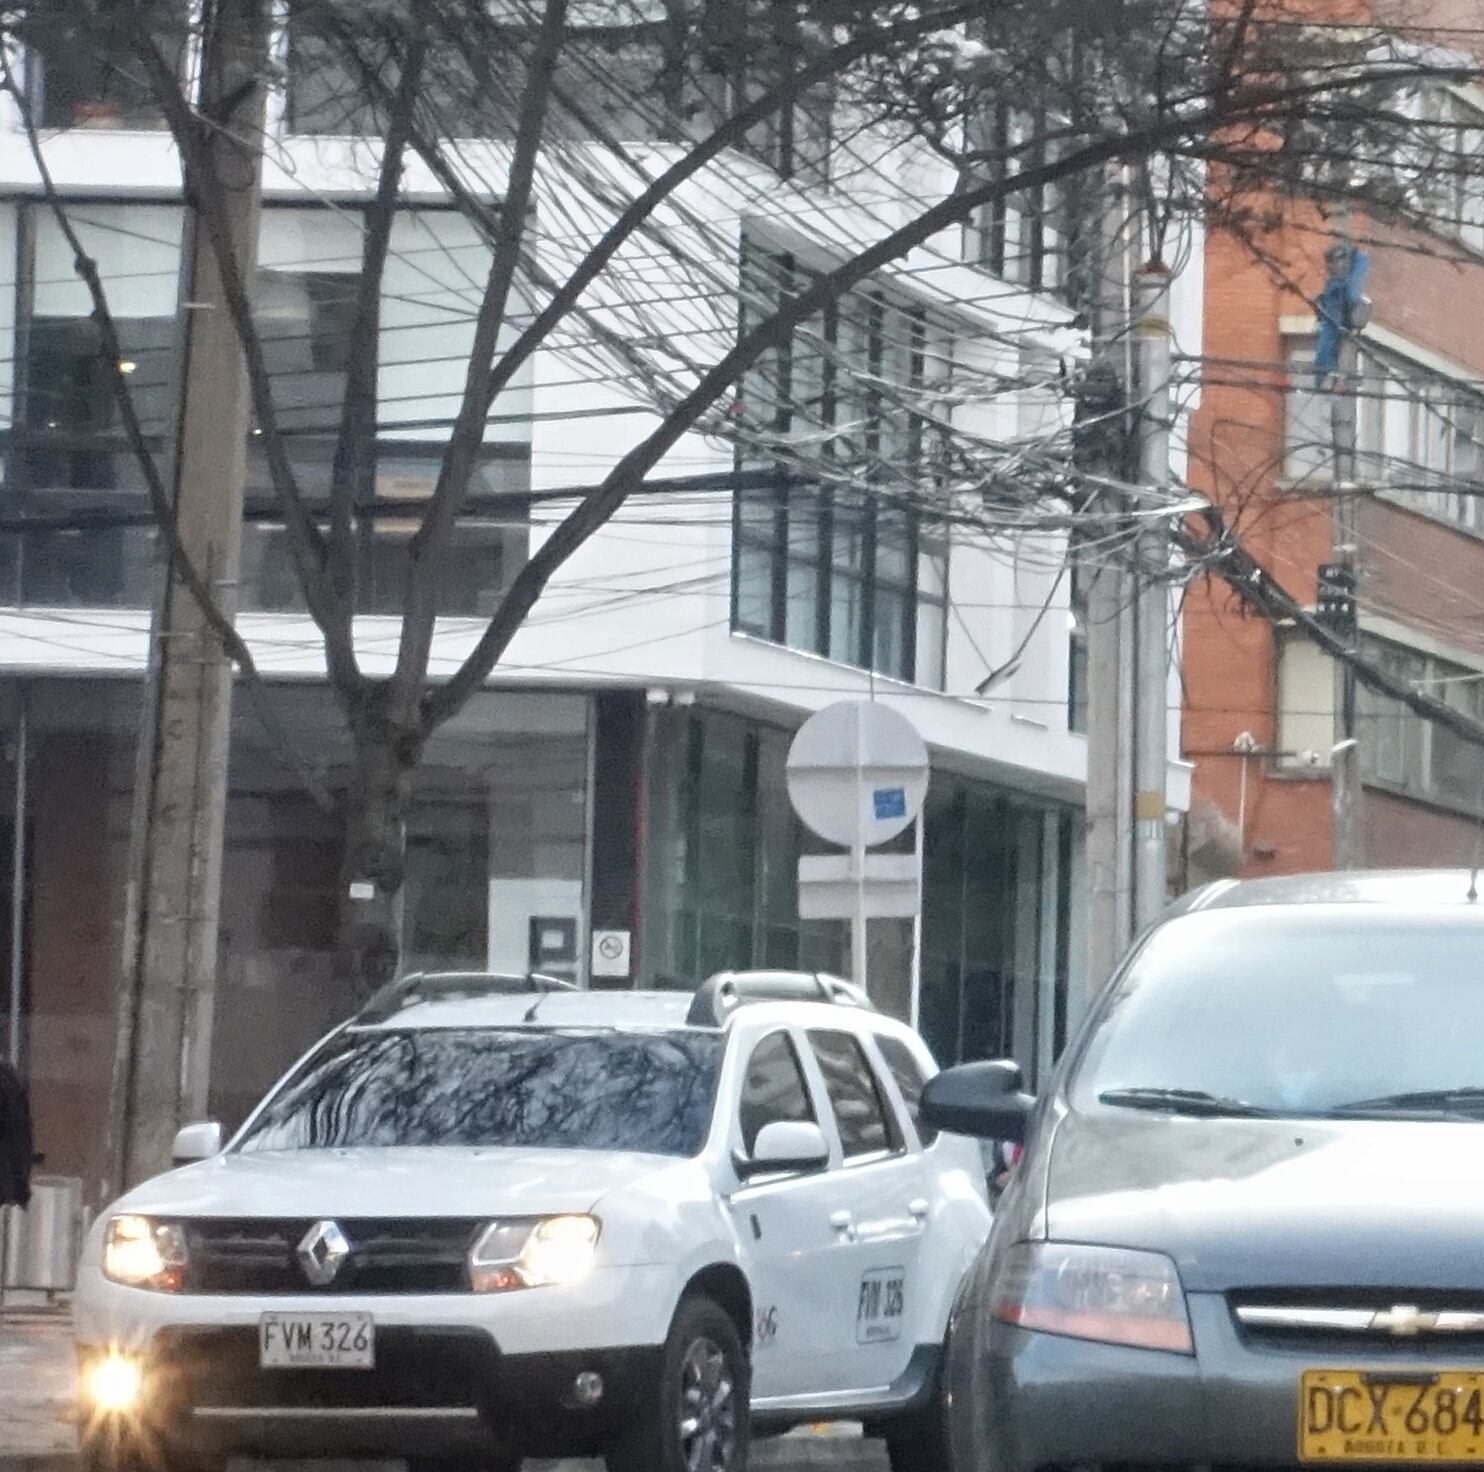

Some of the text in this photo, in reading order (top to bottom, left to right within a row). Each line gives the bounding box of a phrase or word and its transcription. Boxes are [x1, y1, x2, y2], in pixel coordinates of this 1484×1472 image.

[264, 1321, 369, 1351] FVM 326
[1308, 1385, 1390, 1436] DCX
